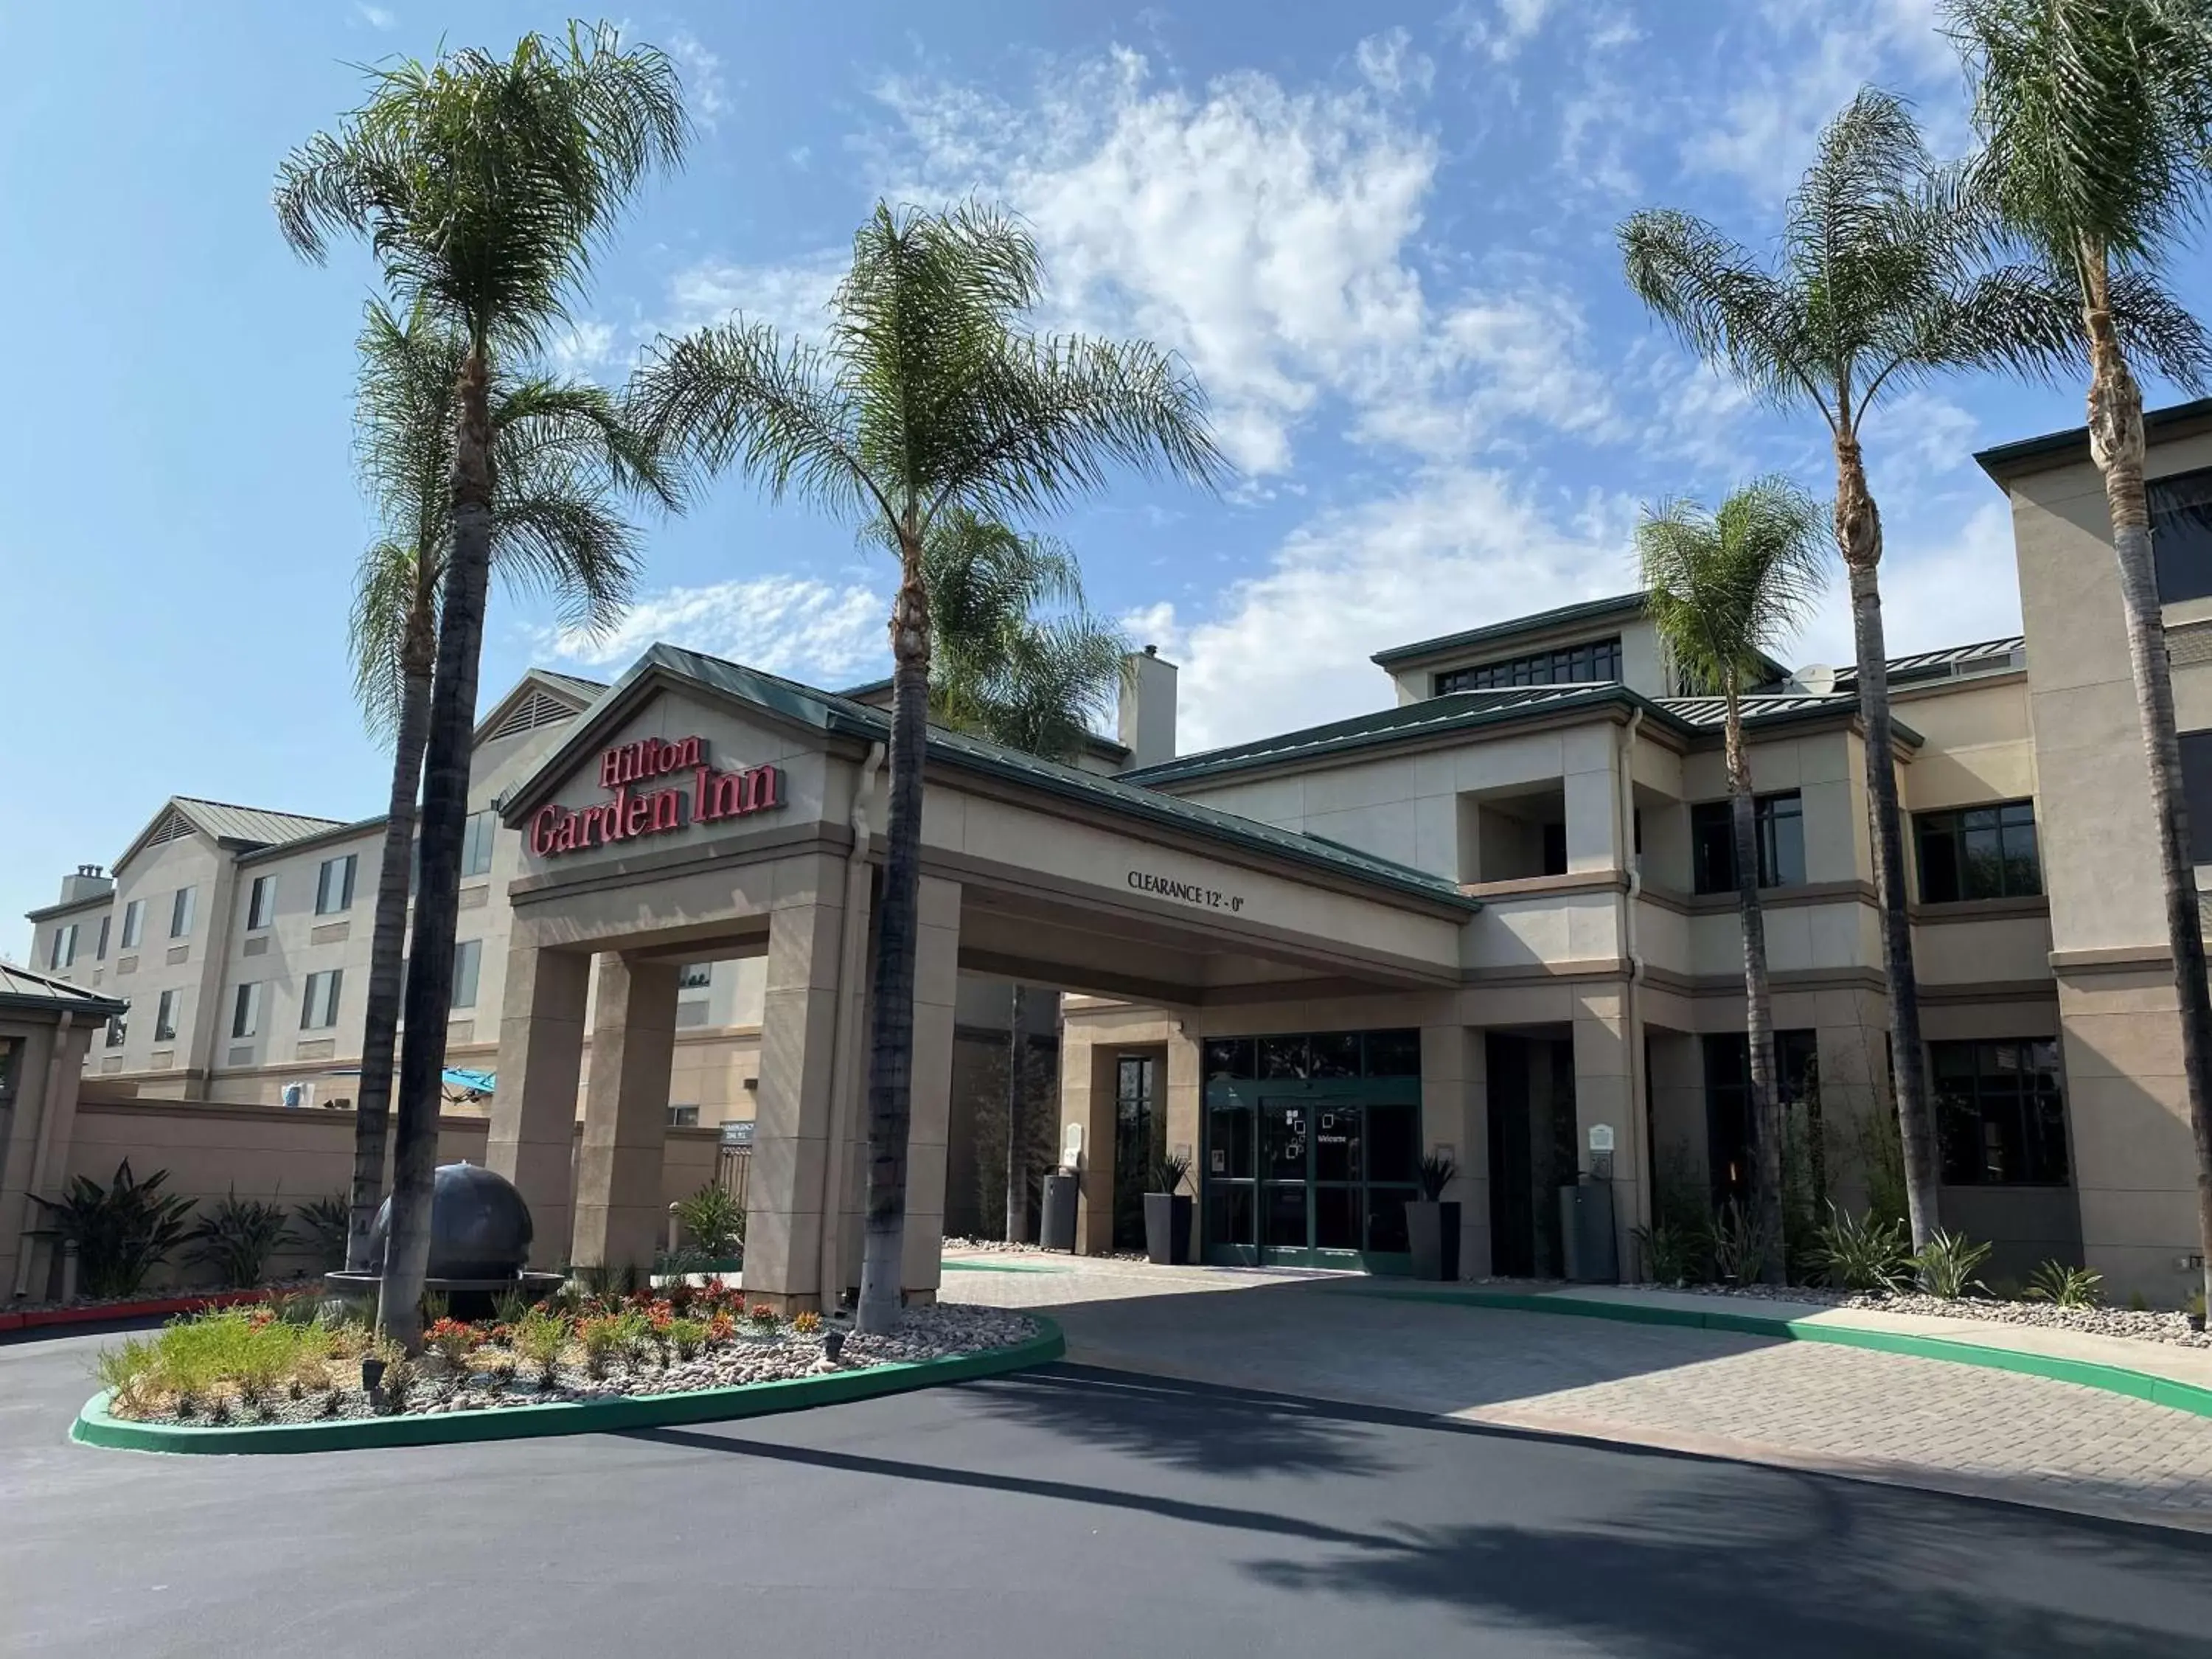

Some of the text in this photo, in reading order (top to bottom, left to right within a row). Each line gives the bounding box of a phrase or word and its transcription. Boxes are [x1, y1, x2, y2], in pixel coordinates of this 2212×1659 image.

[598, 735, 704, 788] Hilton
[529, 764, 779, 859] Garden Inn
[1127, 871, 1202, 904] CLEARANCE
